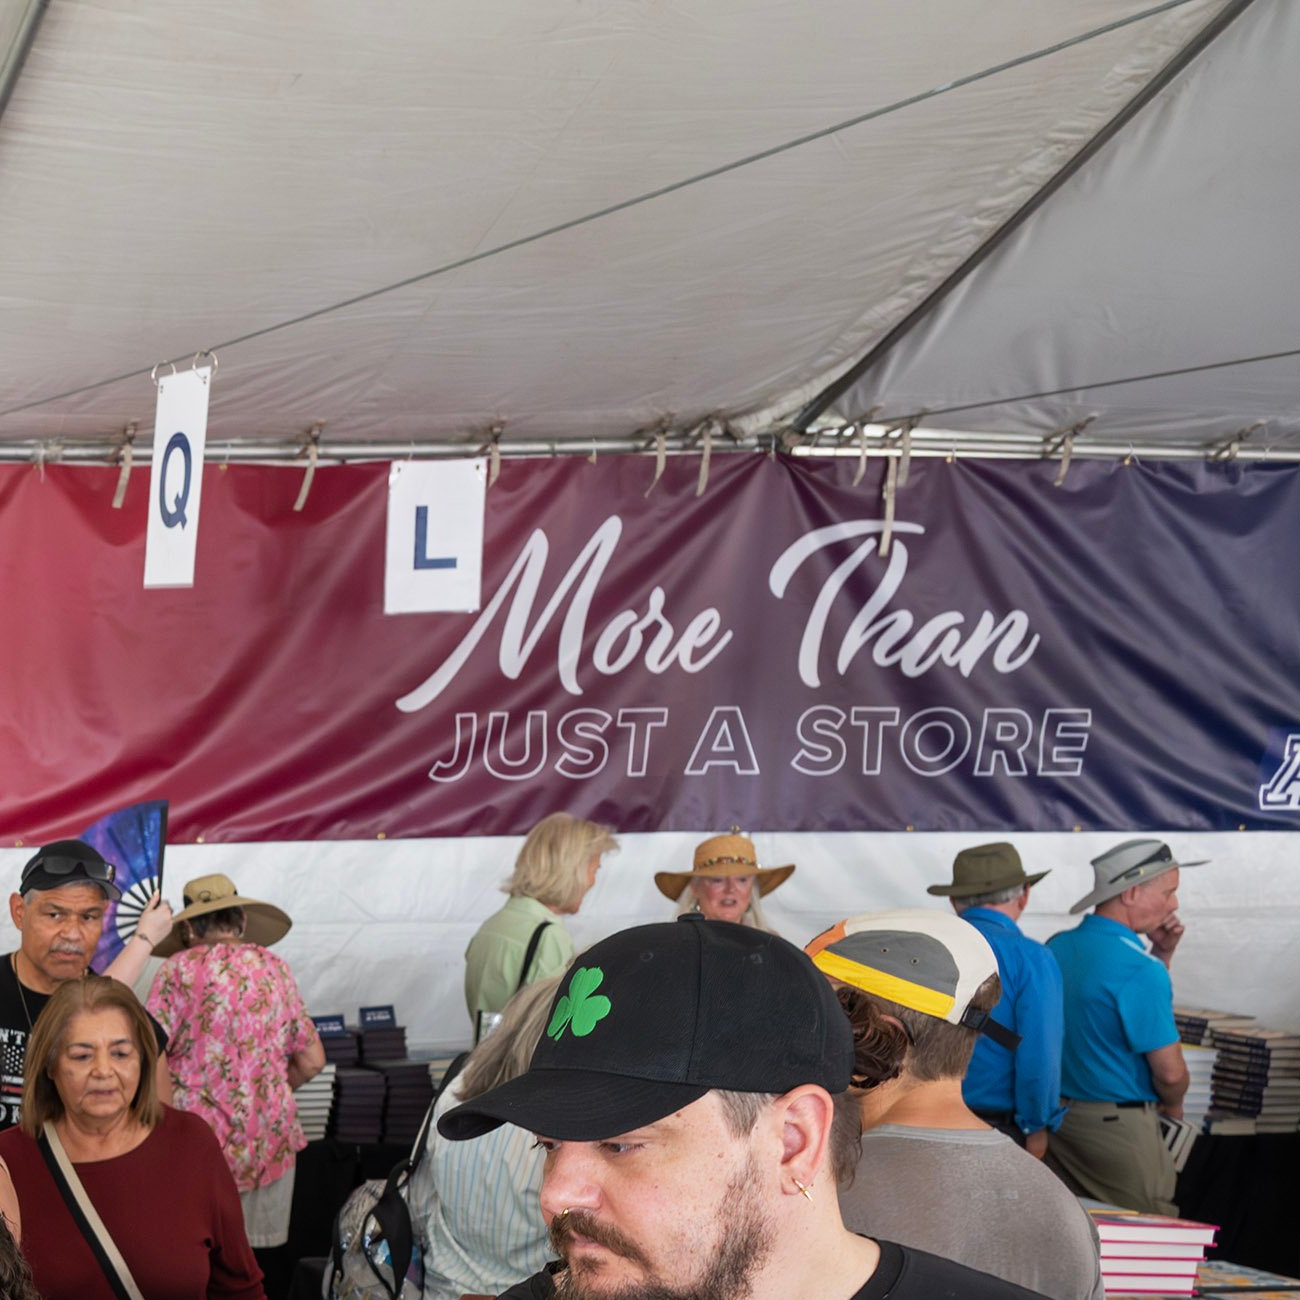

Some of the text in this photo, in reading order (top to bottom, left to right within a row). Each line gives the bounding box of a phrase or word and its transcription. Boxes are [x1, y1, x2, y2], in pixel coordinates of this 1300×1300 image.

[159, 431, 192, 530] Q
[414, 506, 457, 570] L
[395, 514, 1040, 712] More Than
[429, 704, 1092, 783] JUST A STORE
